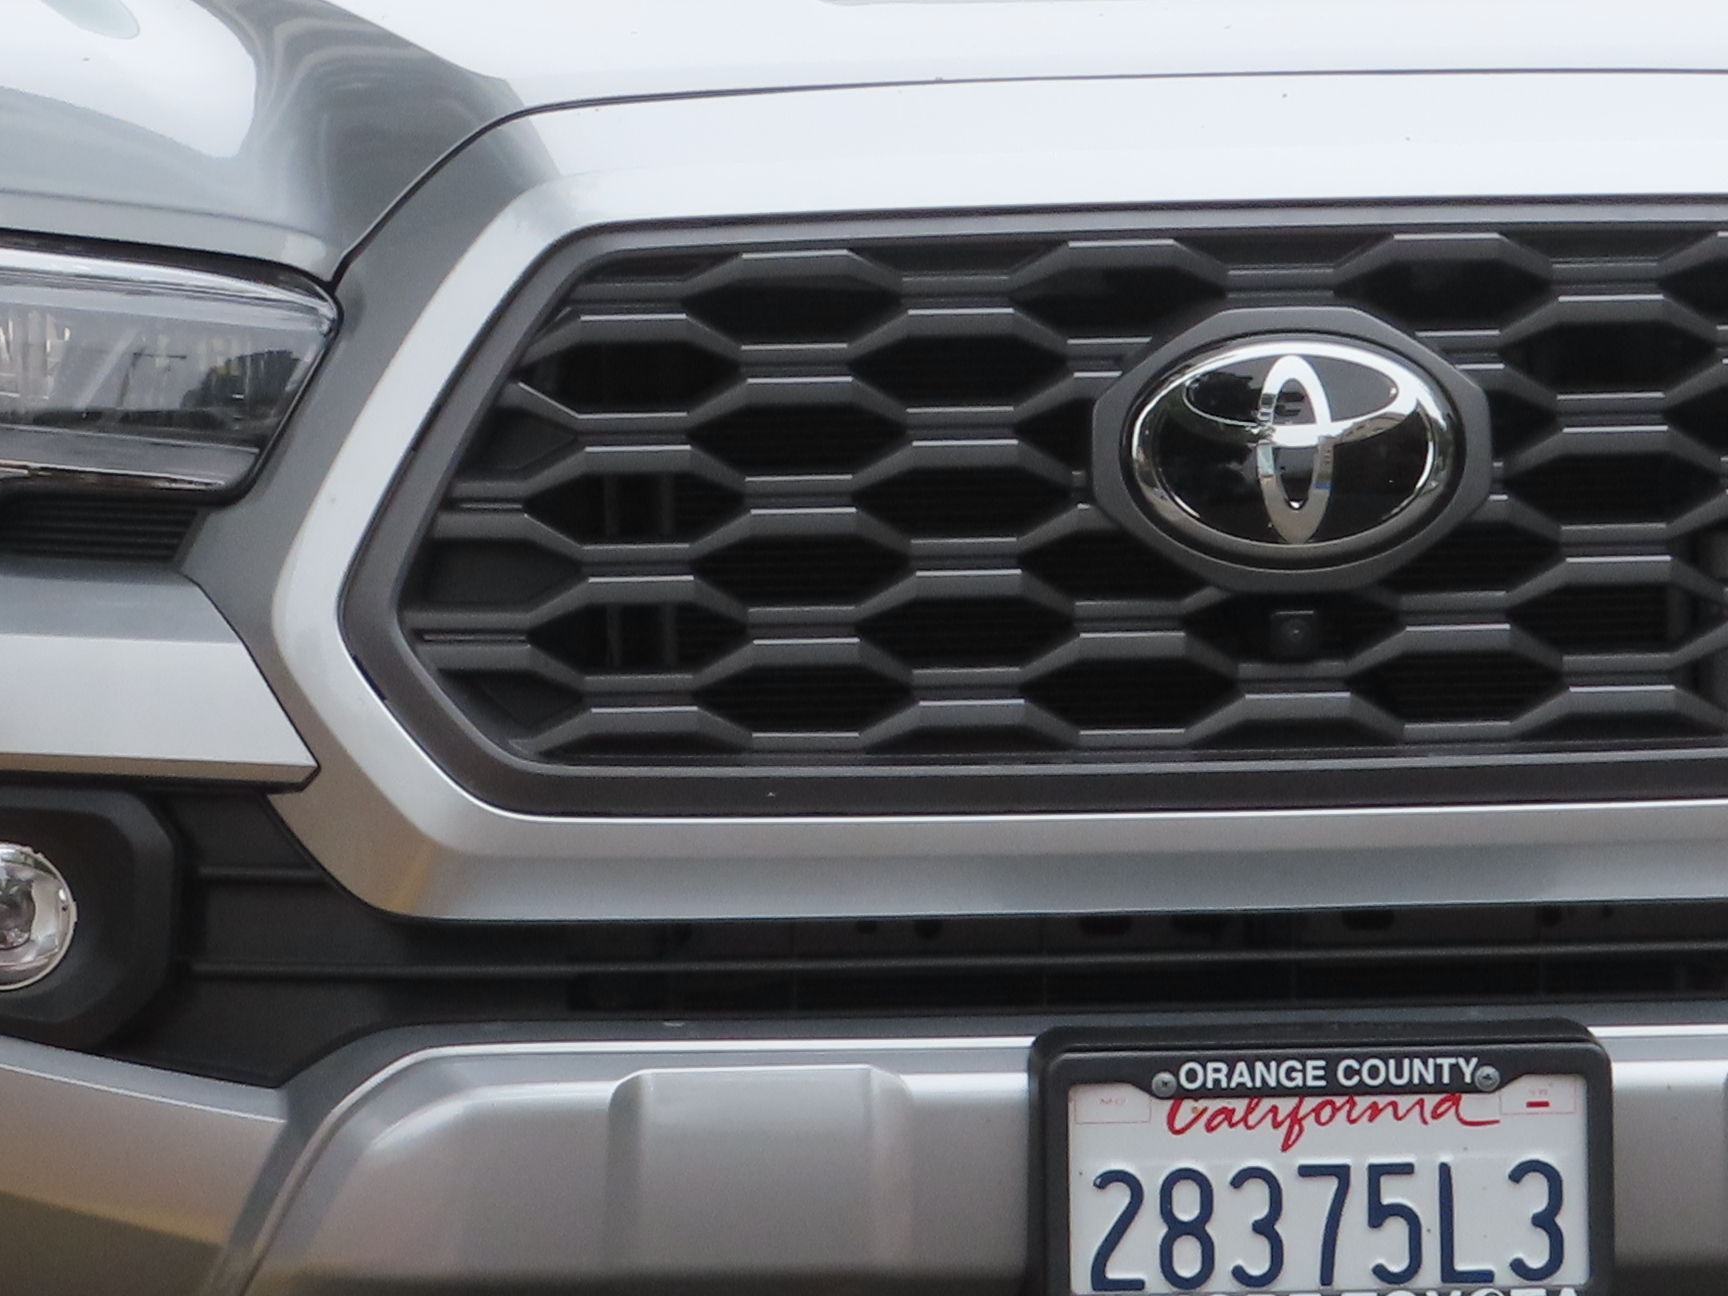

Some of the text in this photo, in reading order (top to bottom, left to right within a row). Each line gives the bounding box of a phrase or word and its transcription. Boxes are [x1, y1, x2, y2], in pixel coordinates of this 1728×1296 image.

[1178, 1056, 1479, 1091] ORANGE COUNTY
[1167, 1092, 1501, 1153] California
[1089, 1159, 1564, 1292] 28375L3
